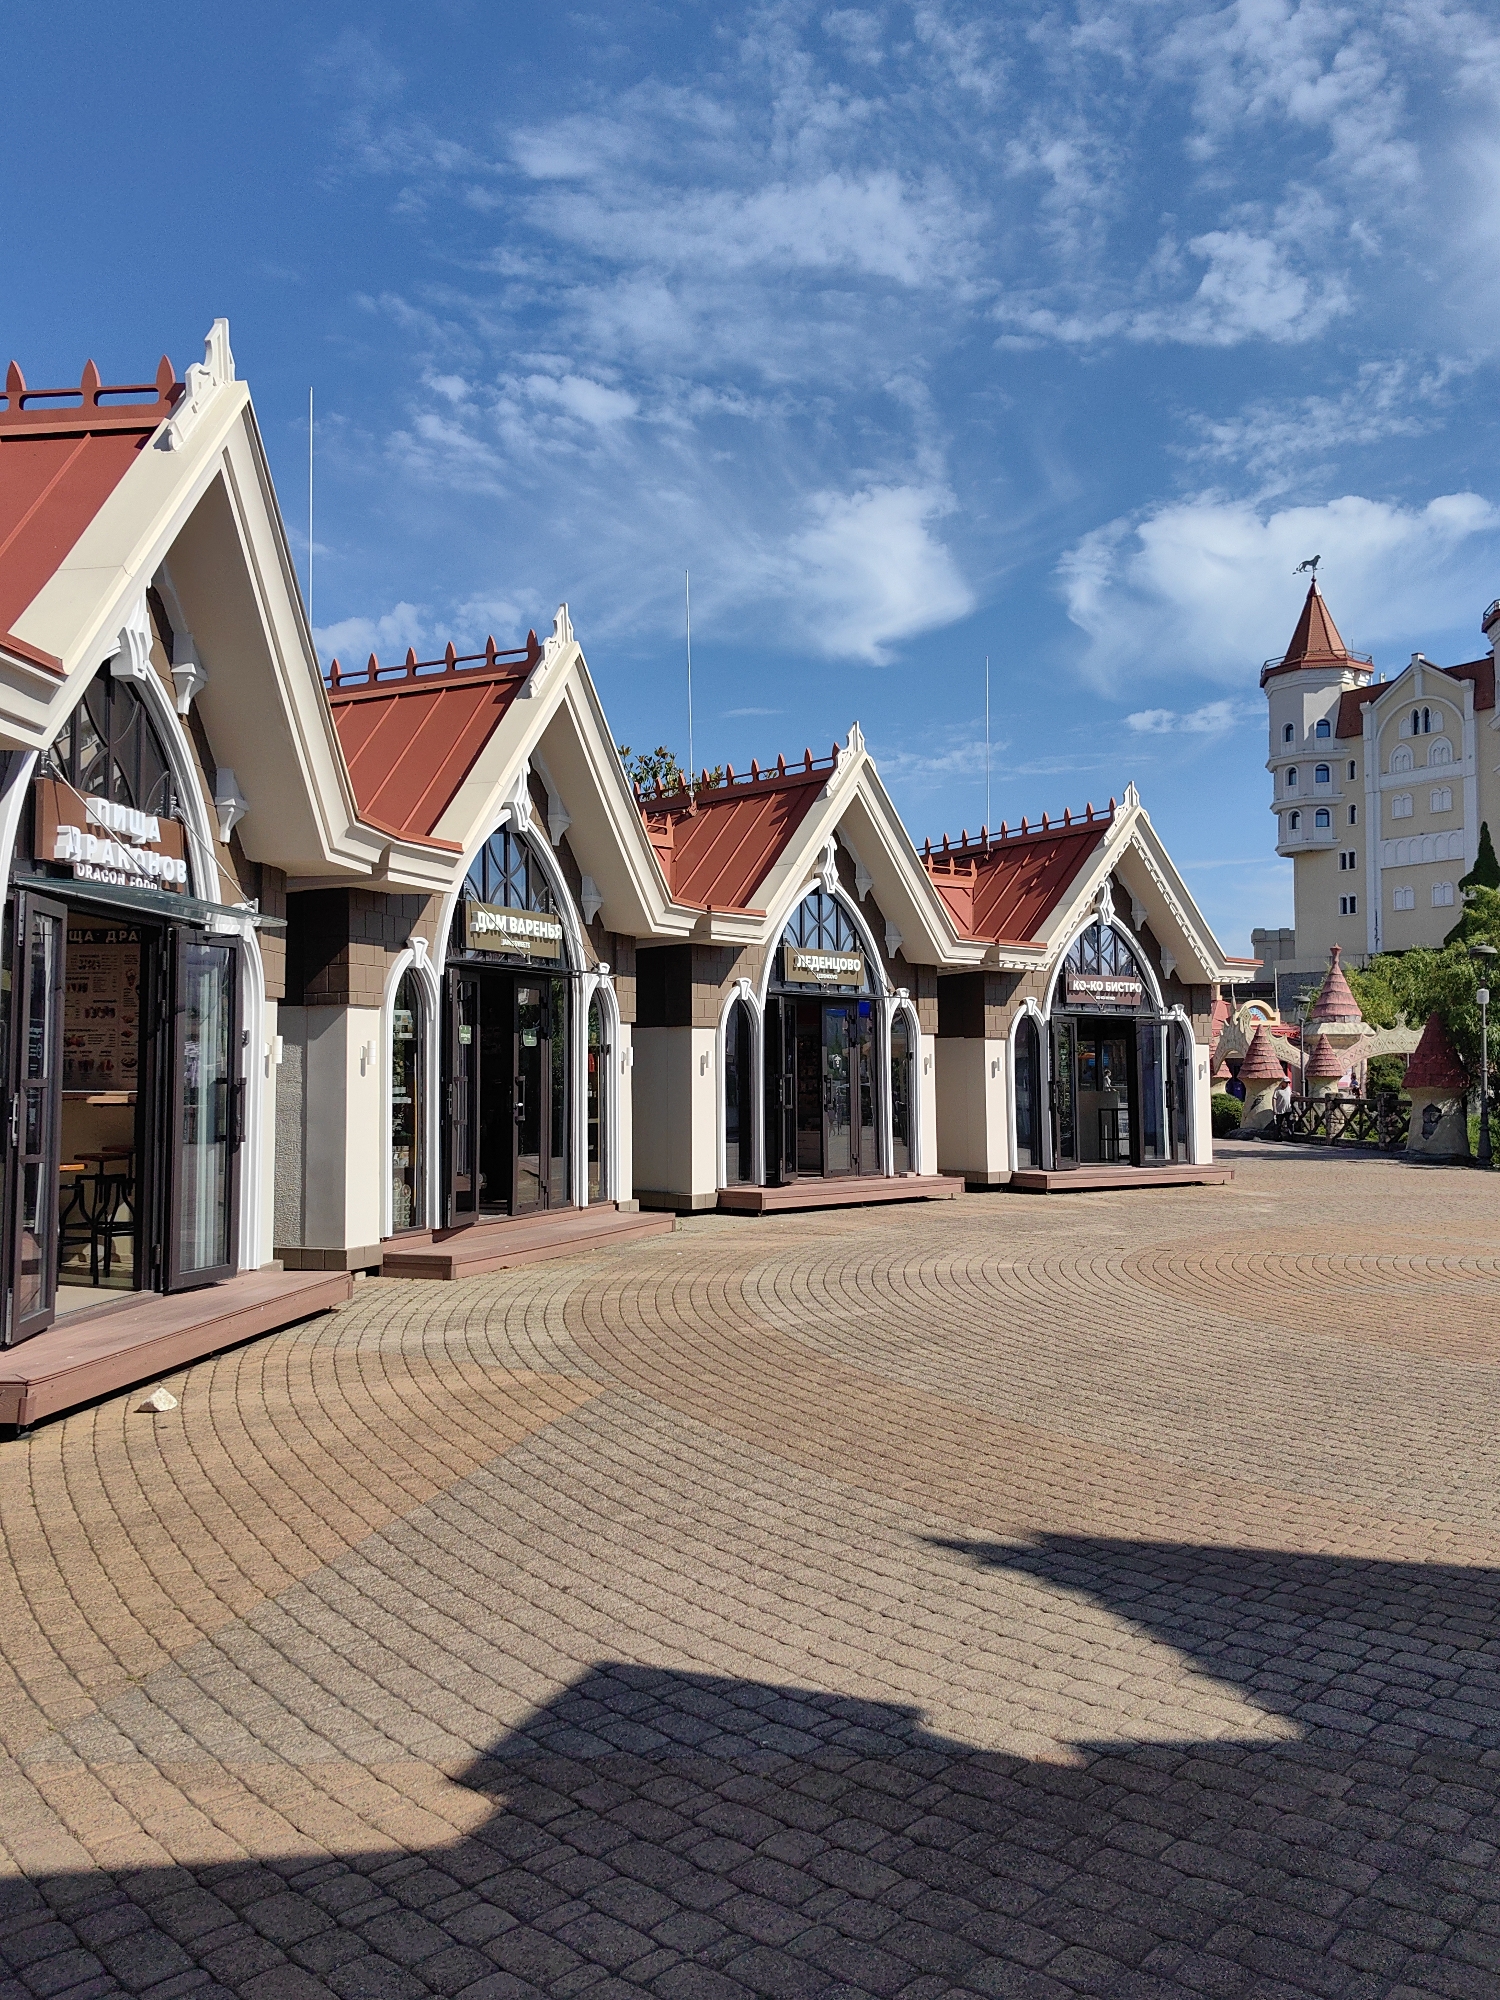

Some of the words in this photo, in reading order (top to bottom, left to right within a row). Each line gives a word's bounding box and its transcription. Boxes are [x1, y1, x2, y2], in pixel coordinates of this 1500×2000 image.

[86, 798, 162, 844] ПИЩА
[54, 825, 188, 883] ДРАКОНОВ
[76, 862, 126, 886] DRAGON
[106, 930, 141, 943] ДРА
[470, 911, 507, 933] ДОМ
[509, 916, 563, 940] ВАРЕНЬЯ
[794, 955, 861, 972] ЛЕДЕНЦОВО
[1073, 980, 1103, 991] КО-КО
[1105, 981, 1142, 993] БИСТРО
